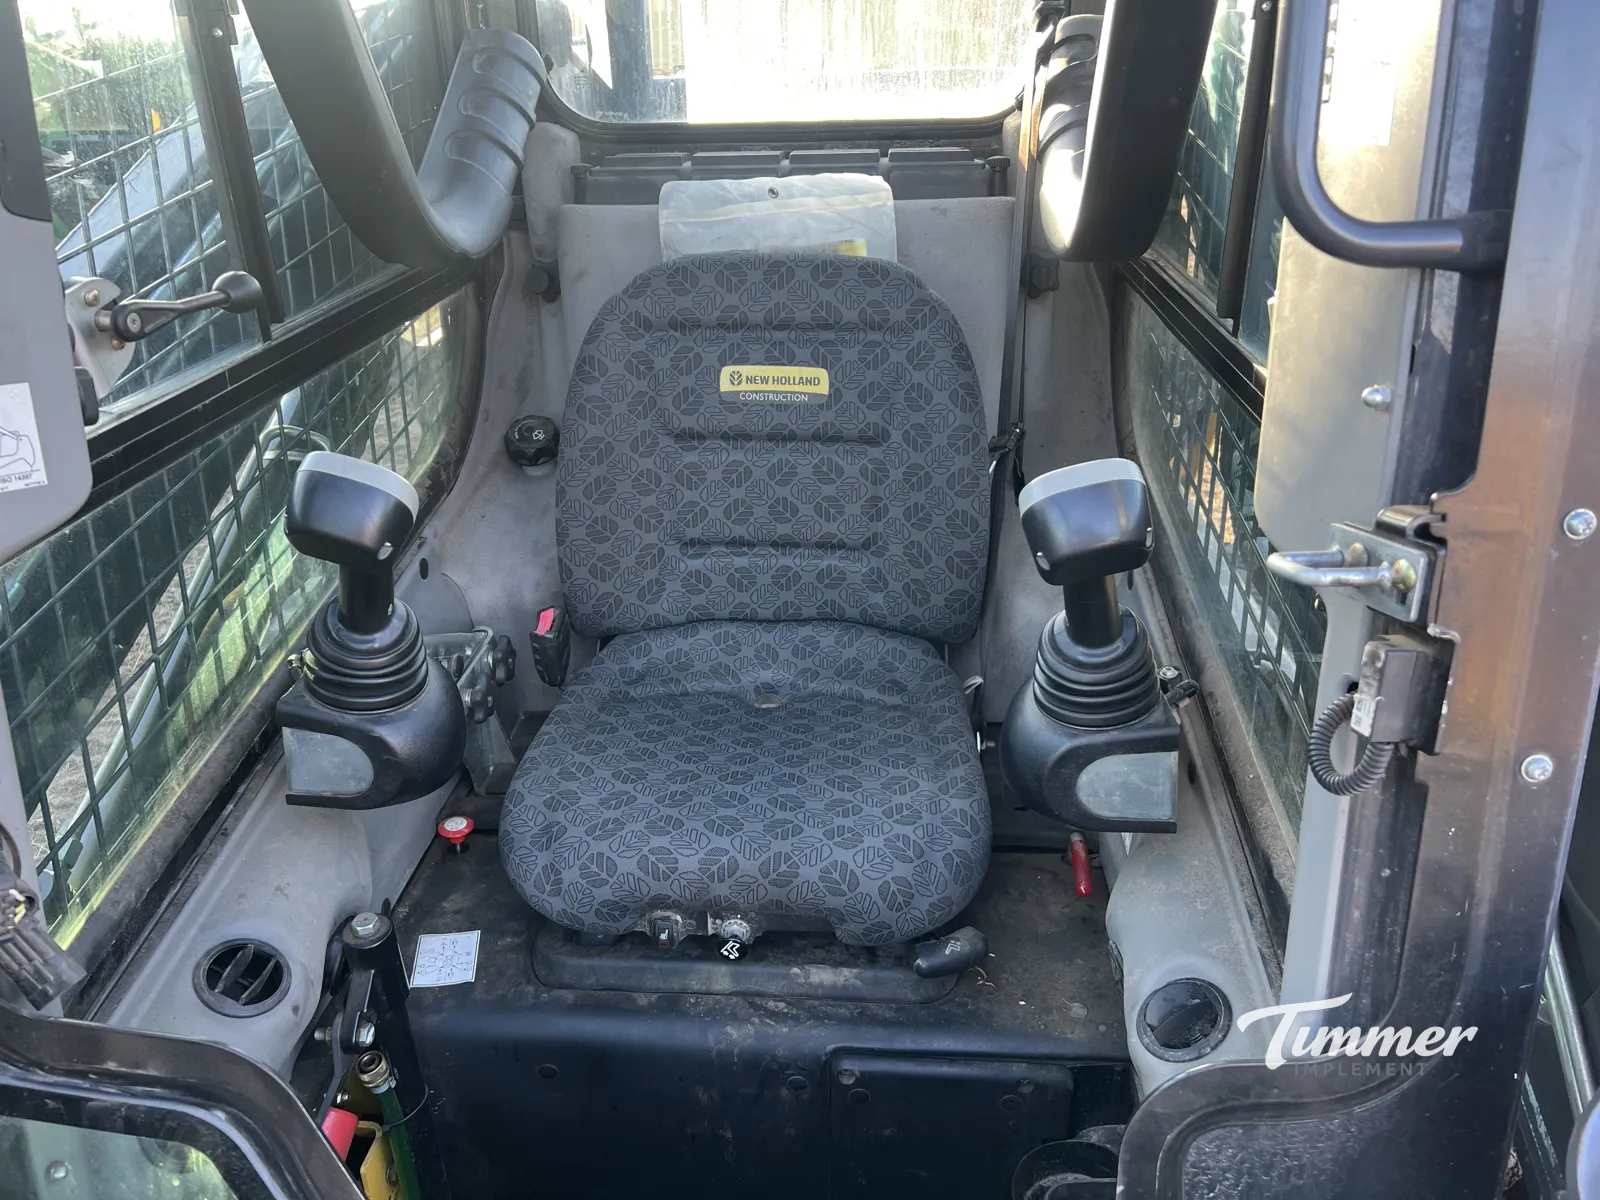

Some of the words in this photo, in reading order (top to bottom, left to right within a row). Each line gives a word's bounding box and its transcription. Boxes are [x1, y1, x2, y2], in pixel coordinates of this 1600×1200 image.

[746, 375, 769, 385] NEW
[772, 375, 820, 386] HOLLAND
[740, 392, 808, 401] CONSTRUCTION
